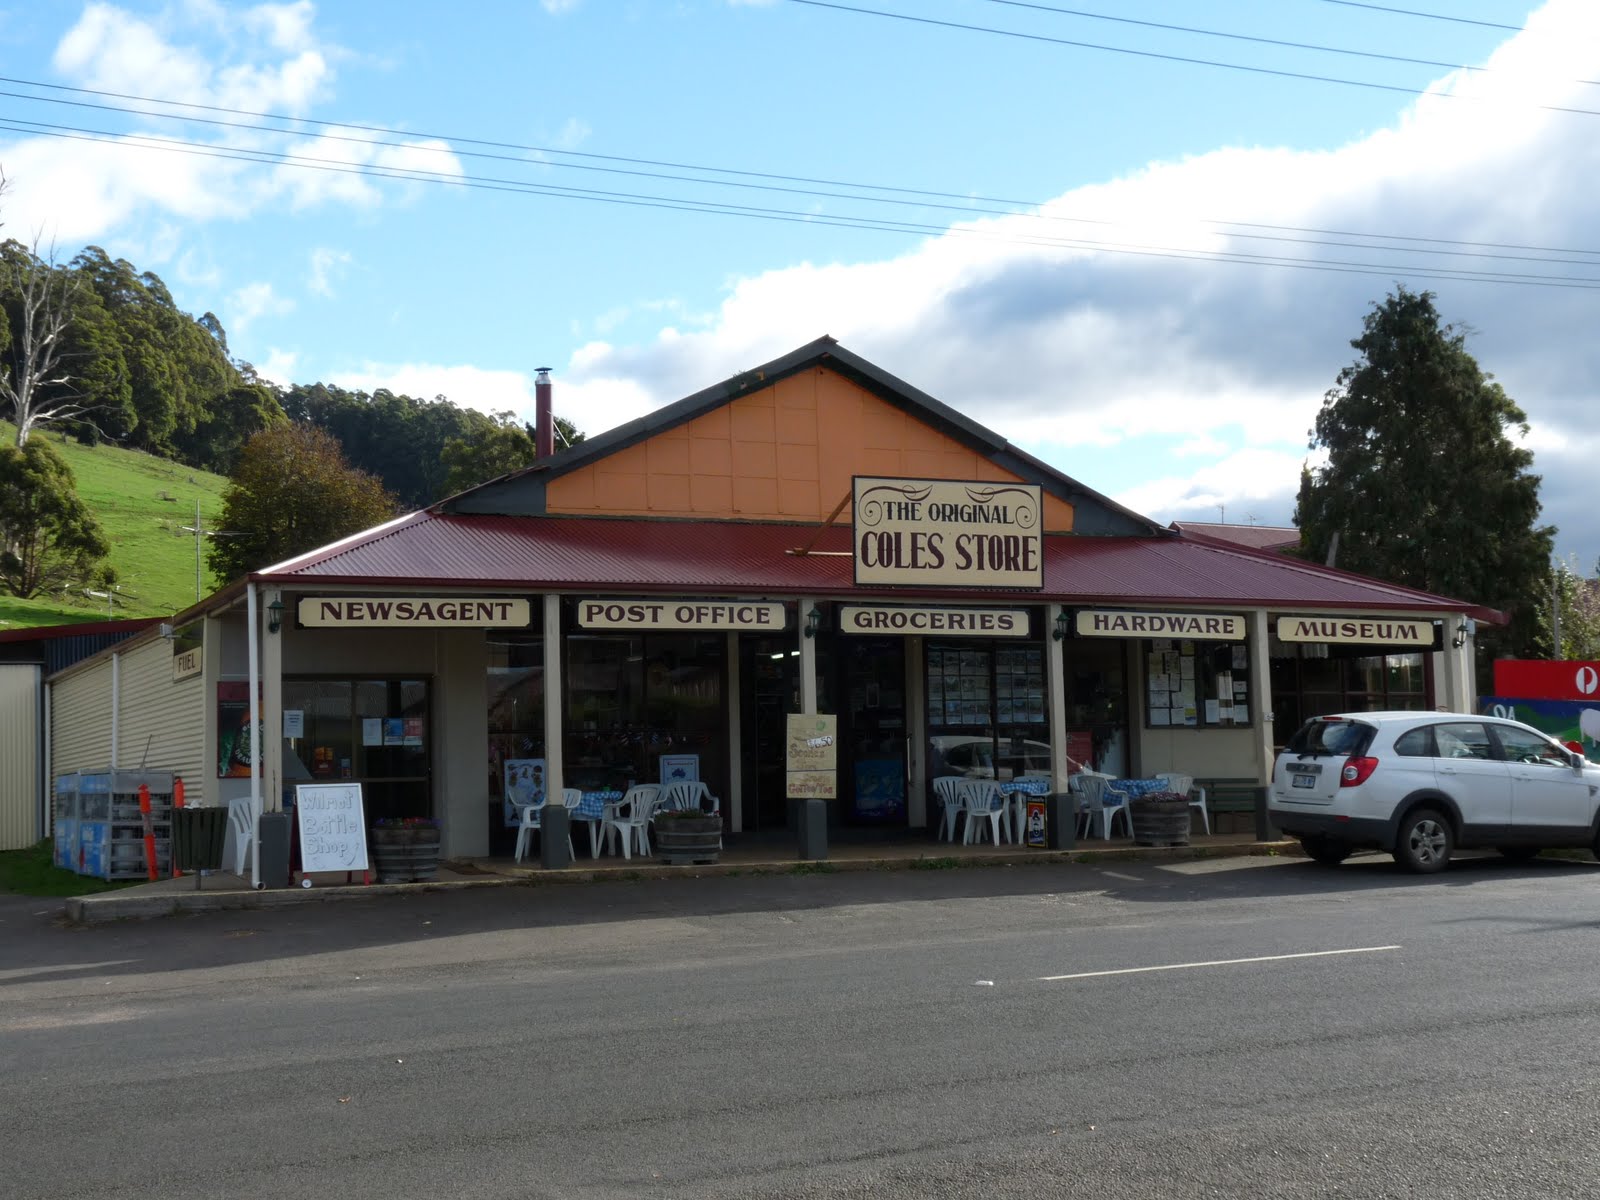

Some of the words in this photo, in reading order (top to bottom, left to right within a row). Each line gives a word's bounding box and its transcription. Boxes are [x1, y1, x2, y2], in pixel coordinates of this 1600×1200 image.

[883, 501, 922, 521] THE
[928, 503, 1014, 524] ORIGINAL
[861, 531, 945, 569] COLES
[955, 533, 1038, 571] STORE
[320, 602, 513, 621] NEWSAGENT
[586, 604, 664, 623] POST
[675, 606, 770, 624] OFFICE
[854, 611, 1014, 630] GROCERIES
[1094, 614, 1234, 634] HARDWARE
[1294, 621, 1419, 640] MUSEUM
[178, 652, 196, 673] FUEL
[303, 814, 358, 836] Bottle
[303, 837, 349, 858] Shop
